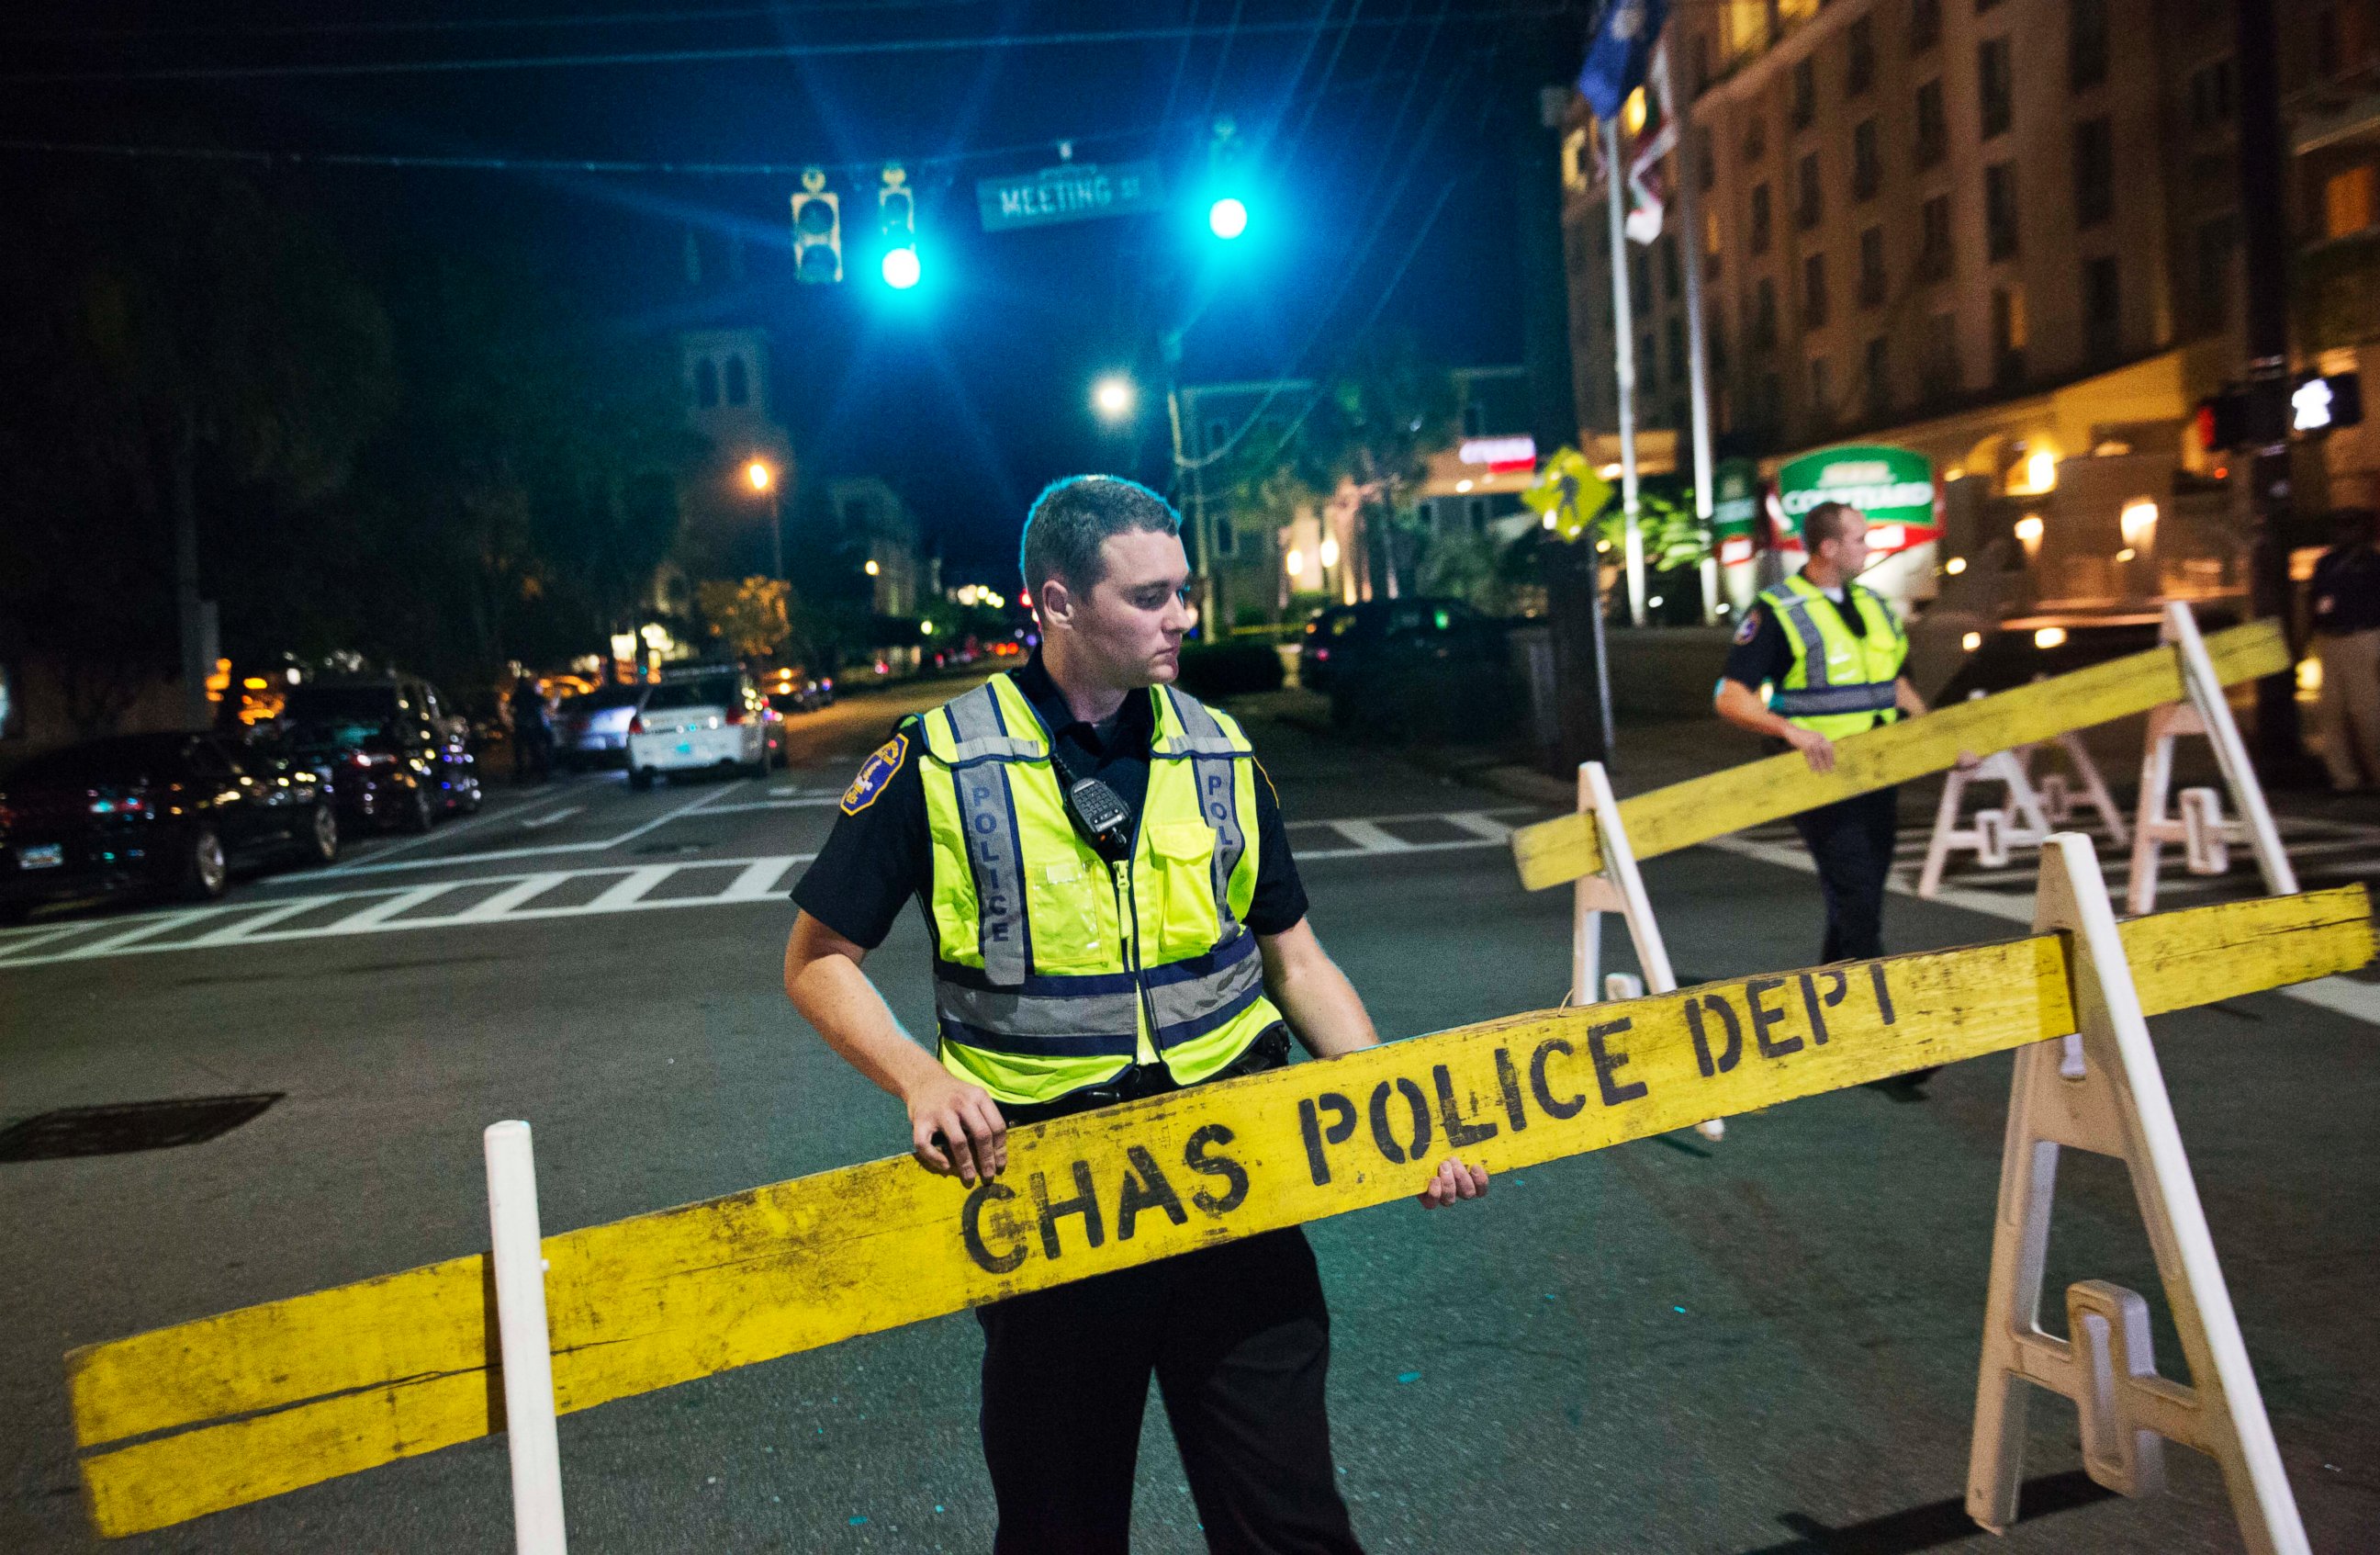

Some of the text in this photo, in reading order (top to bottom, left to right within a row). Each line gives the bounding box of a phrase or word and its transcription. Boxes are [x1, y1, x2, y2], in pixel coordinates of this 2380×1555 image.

[1001, 176, 1111, 217] MEETING
[971, 785, 1009, 942] POLICE
[961, 1123, 1250, 1275] CHAS
[1298, 1016, 1648, 1187] POLICE
